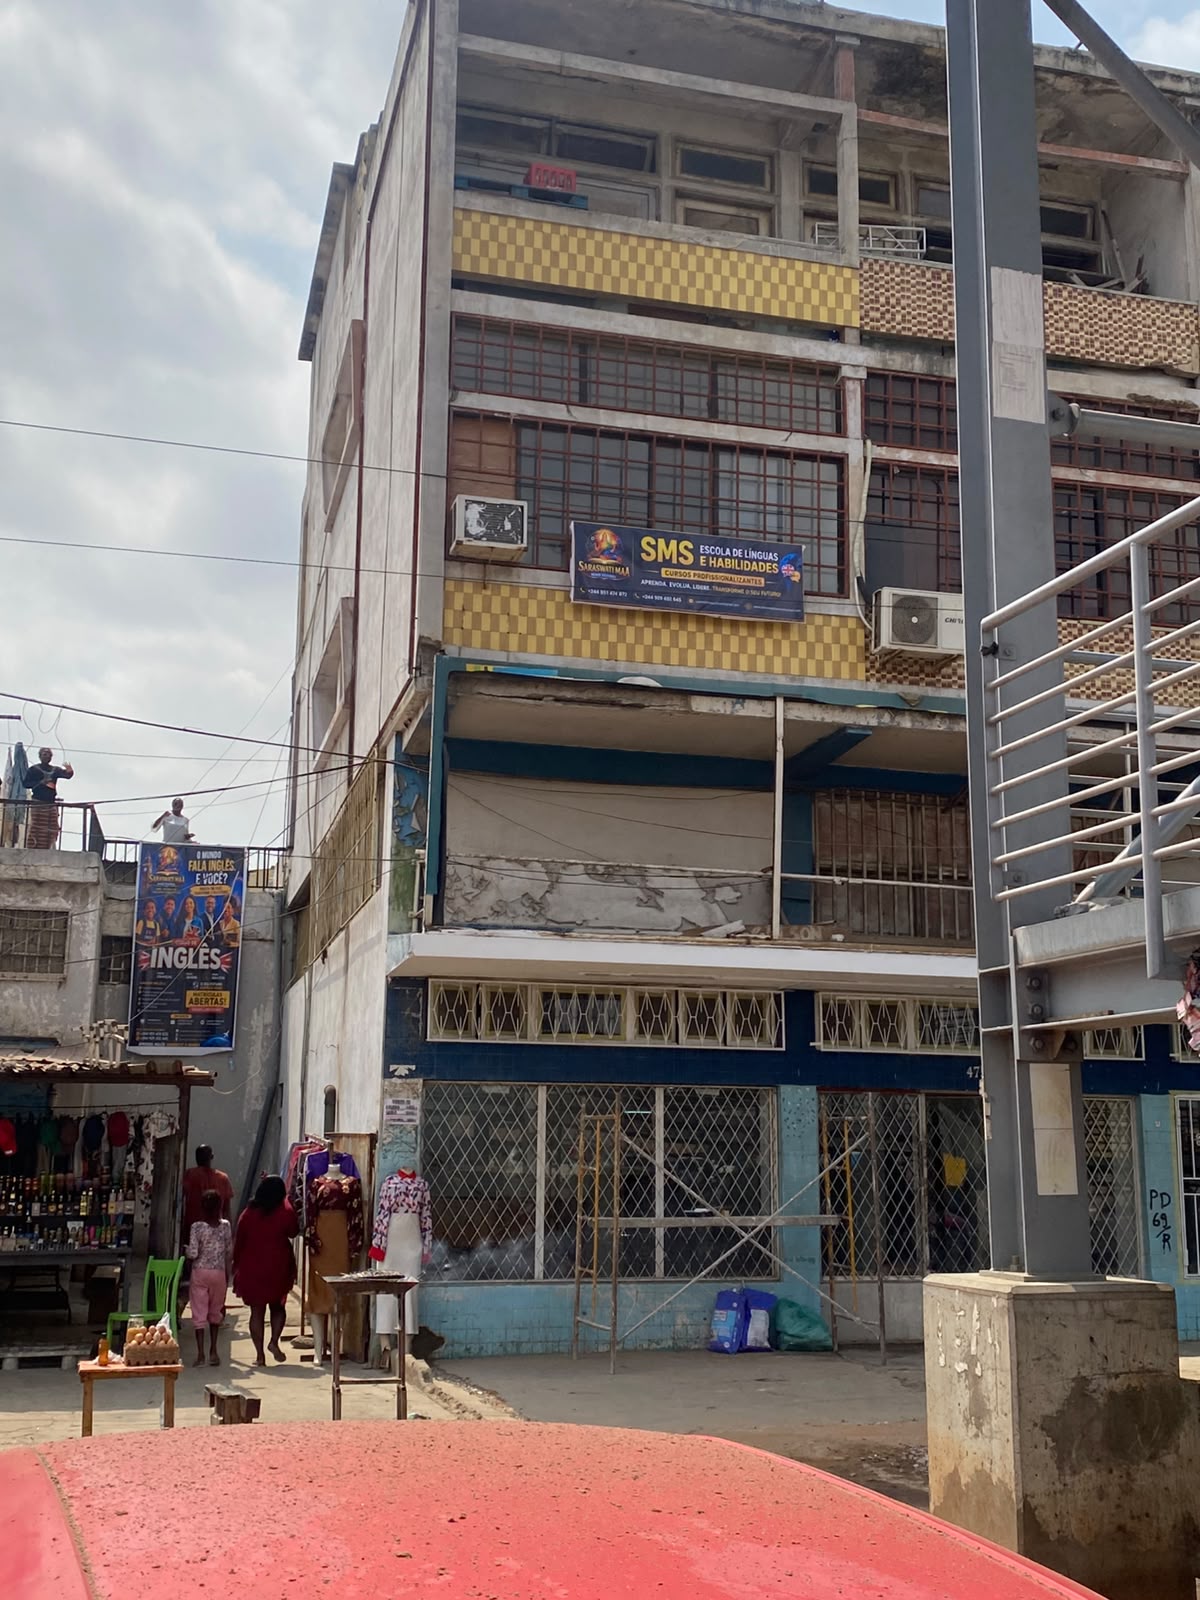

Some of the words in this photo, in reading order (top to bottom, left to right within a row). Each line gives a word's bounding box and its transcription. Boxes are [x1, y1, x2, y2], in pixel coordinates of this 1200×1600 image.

[641, 536, 695, 566] SMS
[700, 545, 731, 557] ESCOLA
[732, 548, 743, 558] DE
[744, 548, 779, 562] LÍNGUAS
[700, 556, 707, 567] E
[709, 556, 779, 574] HABILIDADES
[664, 569, 692, 579] CURSOS
[693, 571, 763, 586] PROFISSIONALIZANTES
[188, 860, 207, 871] FALA
[195, 873, 201, 885] E
[202, 871, 228, 885] VOCÊ?
[150, 943, 221, 970] INGLÊS
[189, 997, 227, 1006] ABERTAS!
